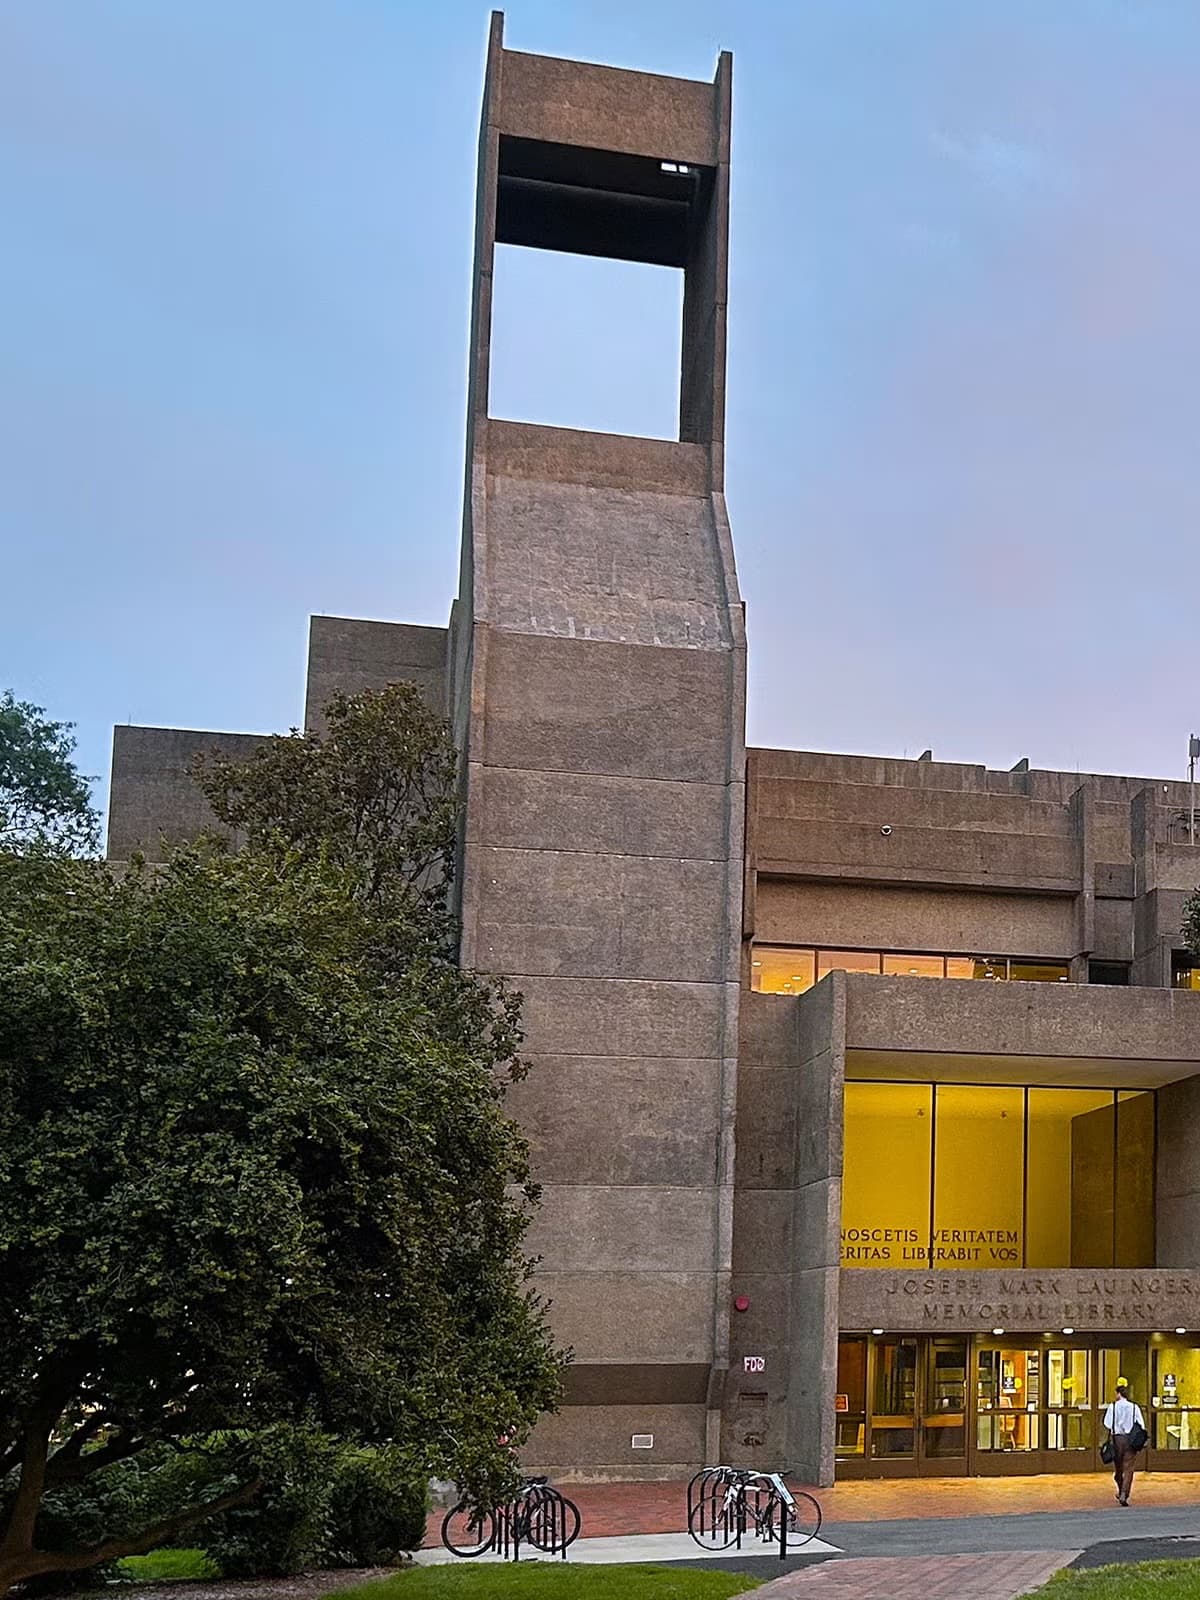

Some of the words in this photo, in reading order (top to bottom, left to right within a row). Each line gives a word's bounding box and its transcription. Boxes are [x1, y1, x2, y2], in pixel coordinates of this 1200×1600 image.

[989, 1247, 1018, 1260] VOS
[886, 1279, 982, 1296] JOSEPH
[1001, 1279, 1061, 1296] MARK
[1076, 1279, 1193, 1296] LAUINGER
[923, 1303, 1049, 1320] MEMORIAL
[1064, 1303, 1159, 1321] LIBRARY
